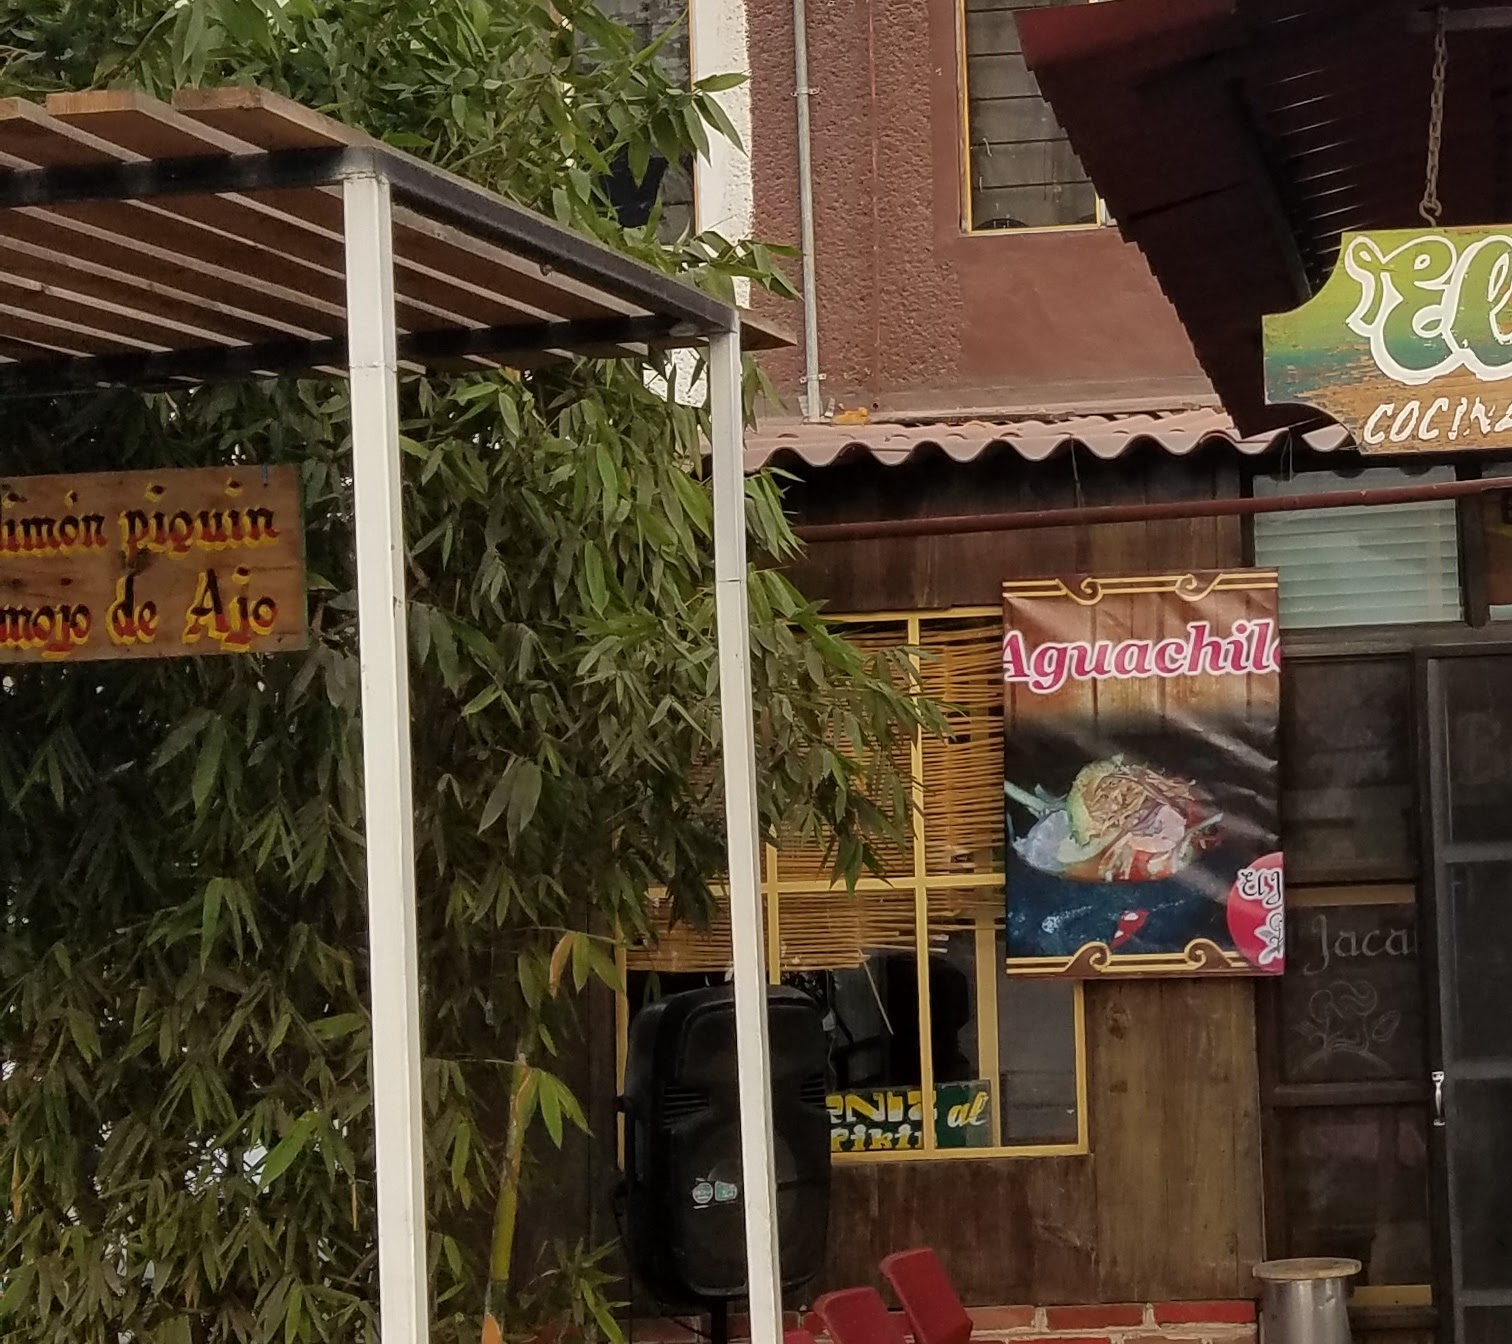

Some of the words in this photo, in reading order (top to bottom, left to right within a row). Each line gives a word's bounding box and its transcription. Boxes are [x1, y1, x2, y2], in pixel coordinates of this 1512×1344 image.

[0, 489, 108, 556] imón
[106, 570, 159, 645] de
[182, 566, 279, 652] Ajo
[1003, 620, 1281, 692] Aguachil
